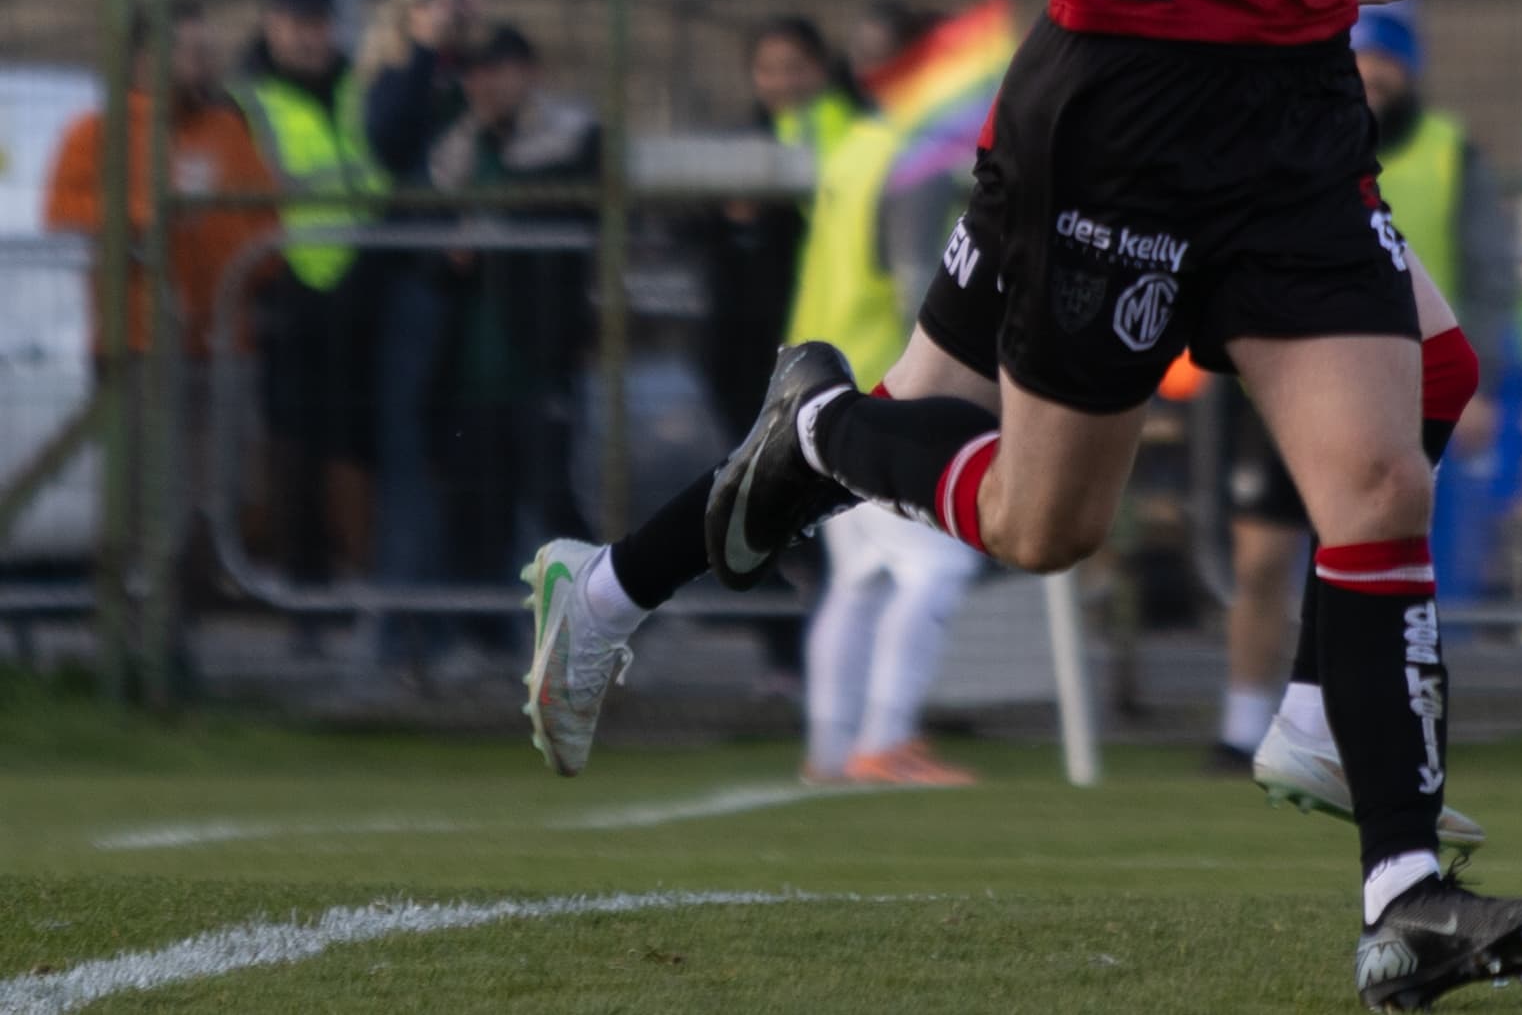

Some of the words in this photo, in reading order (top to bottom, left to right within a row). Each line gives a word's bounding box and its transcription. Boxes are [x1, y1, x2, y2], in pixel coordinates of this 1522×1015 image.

[1056, 210, 1112, 250] des
[1117, 227, 1189, 273] kelly
[1119, 277, 1178, 346] MG
